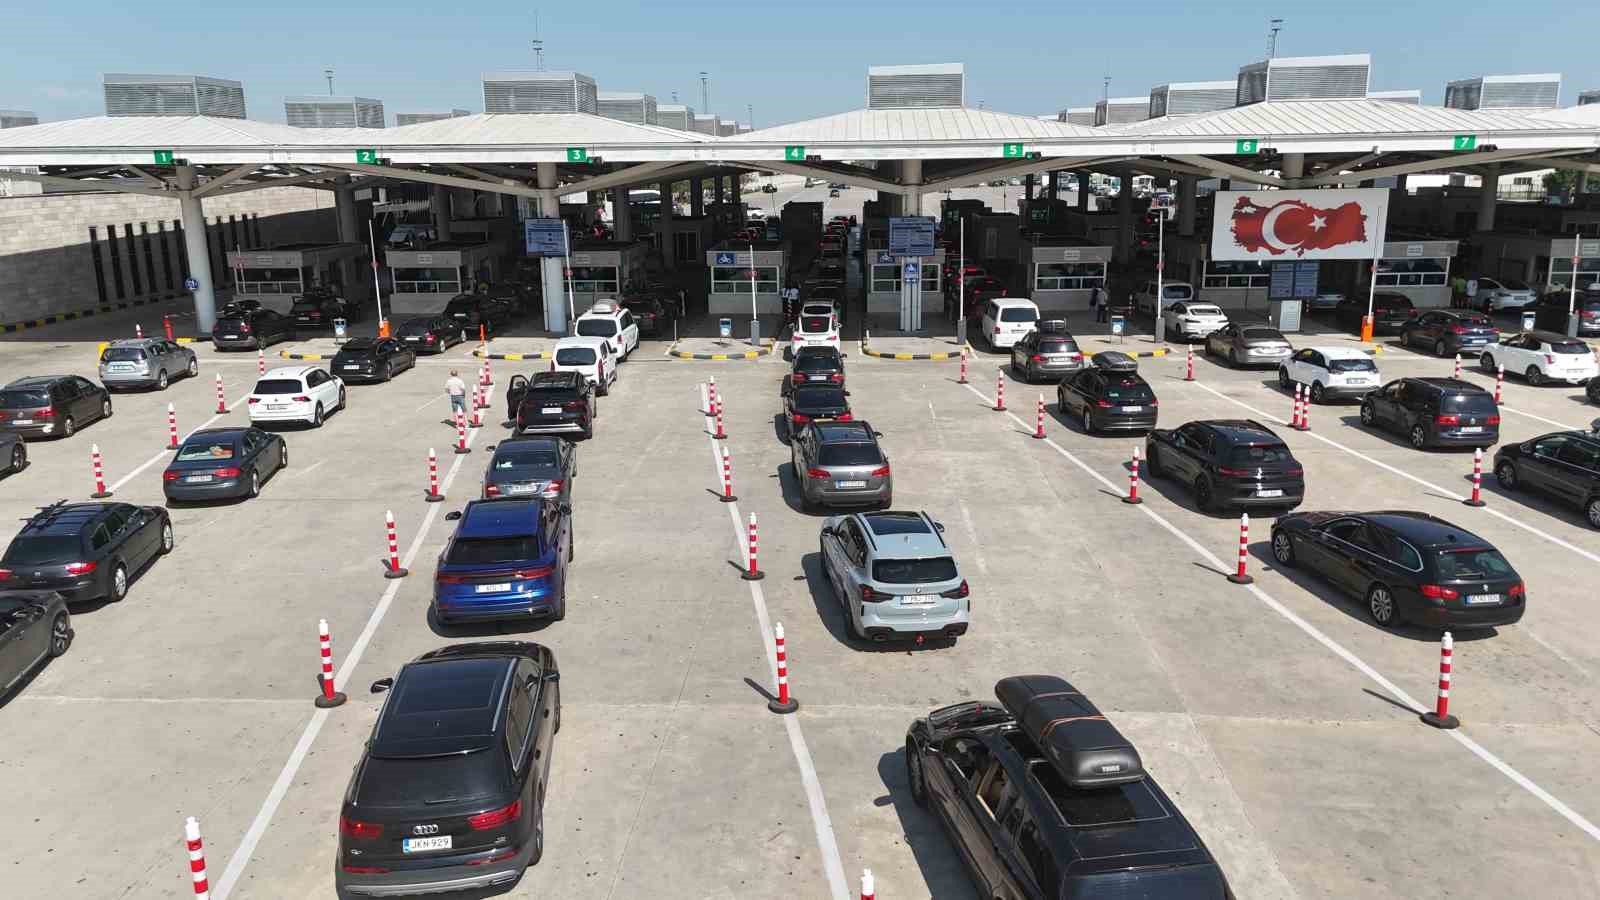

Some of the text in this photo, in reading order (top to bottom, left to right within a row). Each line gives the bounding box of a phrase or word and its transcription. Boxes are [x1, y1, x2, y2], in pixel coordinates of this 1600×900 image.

[1242, 142, 1251, 152] 6
[1462, 137, 1470, 147] 7
[573, 150, 581, 160] 3
[791, 148, 799, 157] 4
[1009, 145, 1017, 155] 5
[362, 151, 370, 161] 2
